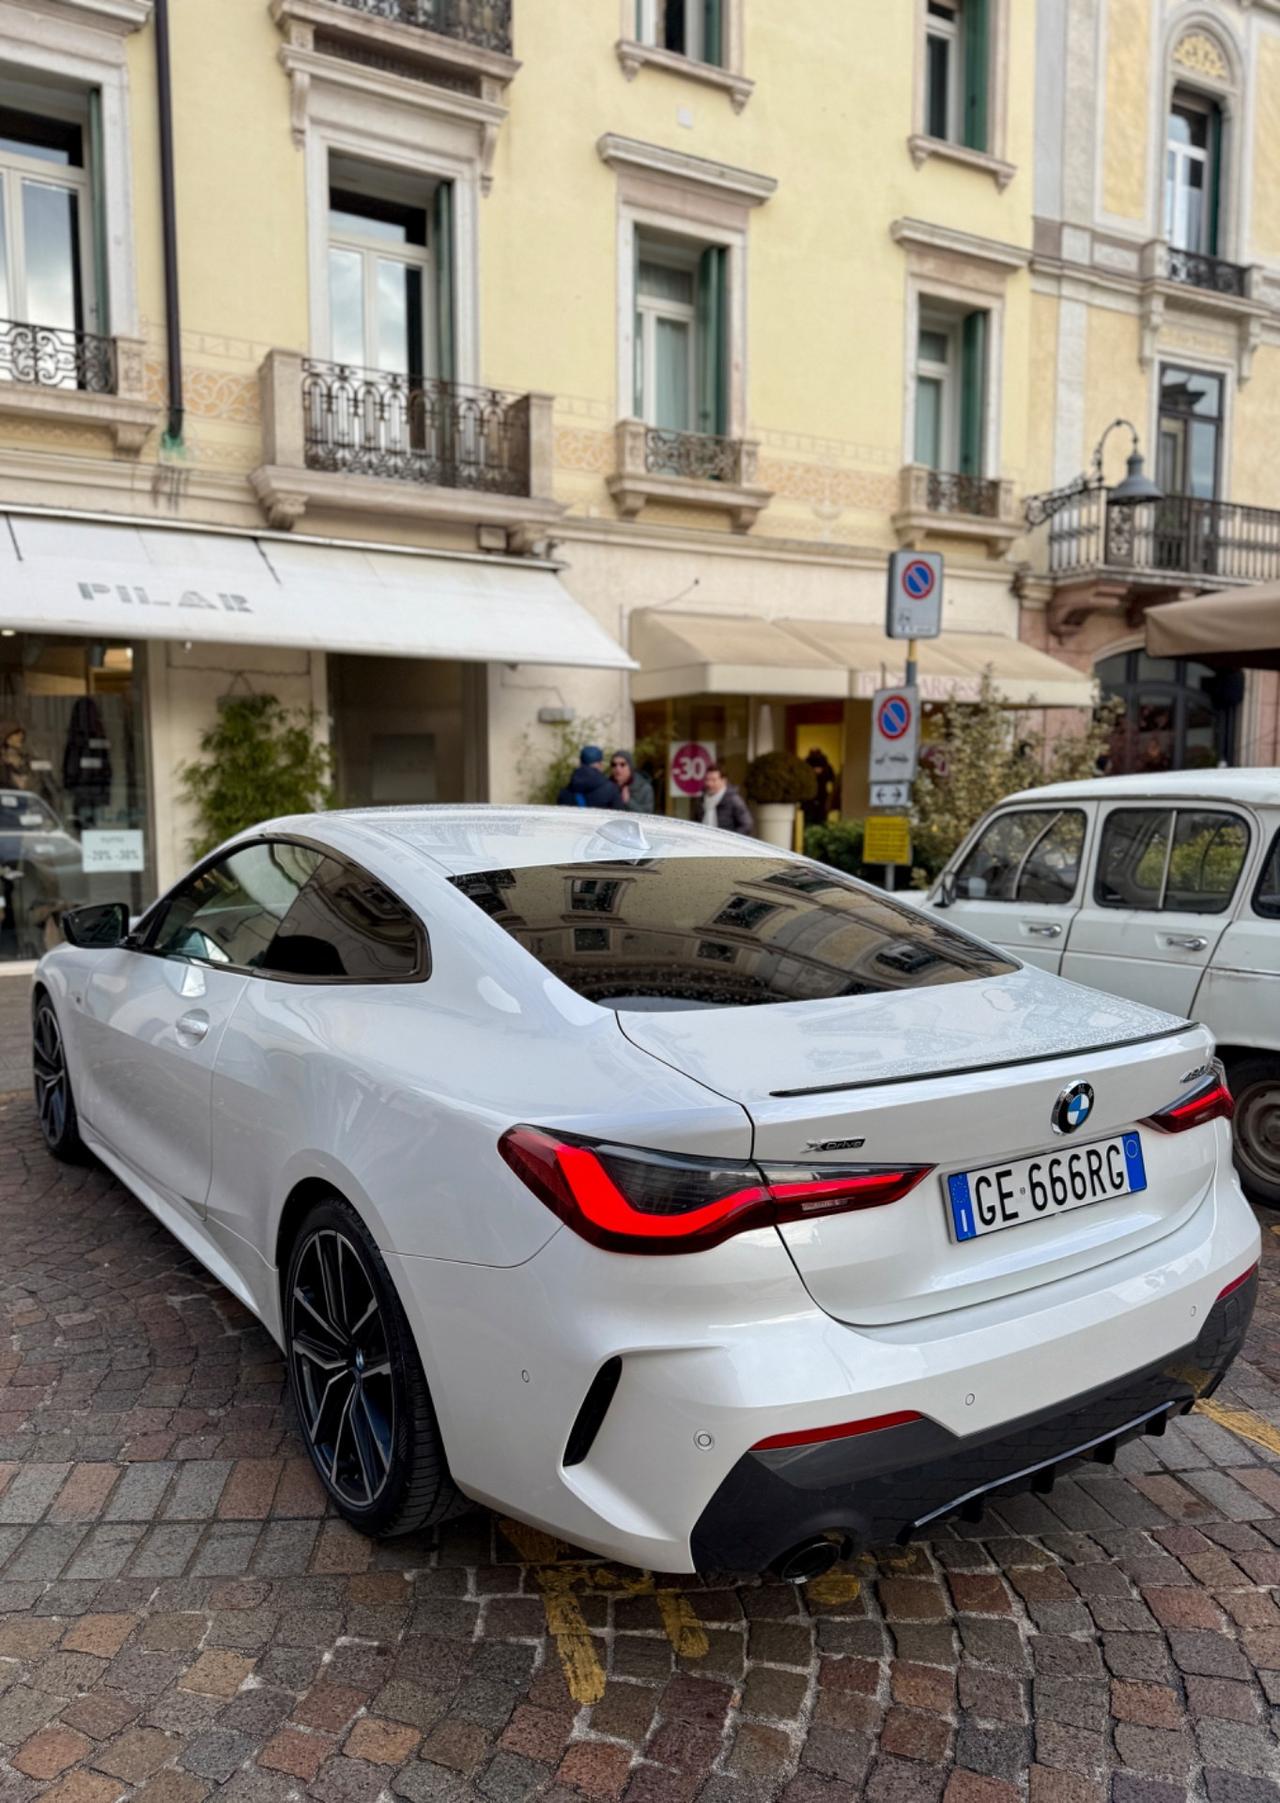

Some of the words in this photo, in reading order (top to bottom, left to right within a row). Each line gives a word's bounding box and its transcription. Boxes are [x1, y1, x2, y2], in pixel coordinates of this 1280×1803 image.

[78, 582, 254, 613] PILAR
[672, 757, 706, 781] -30
[975, 1169, 1019, 1226] GE
[1028, 1145, 1125, 1211] 666RG
